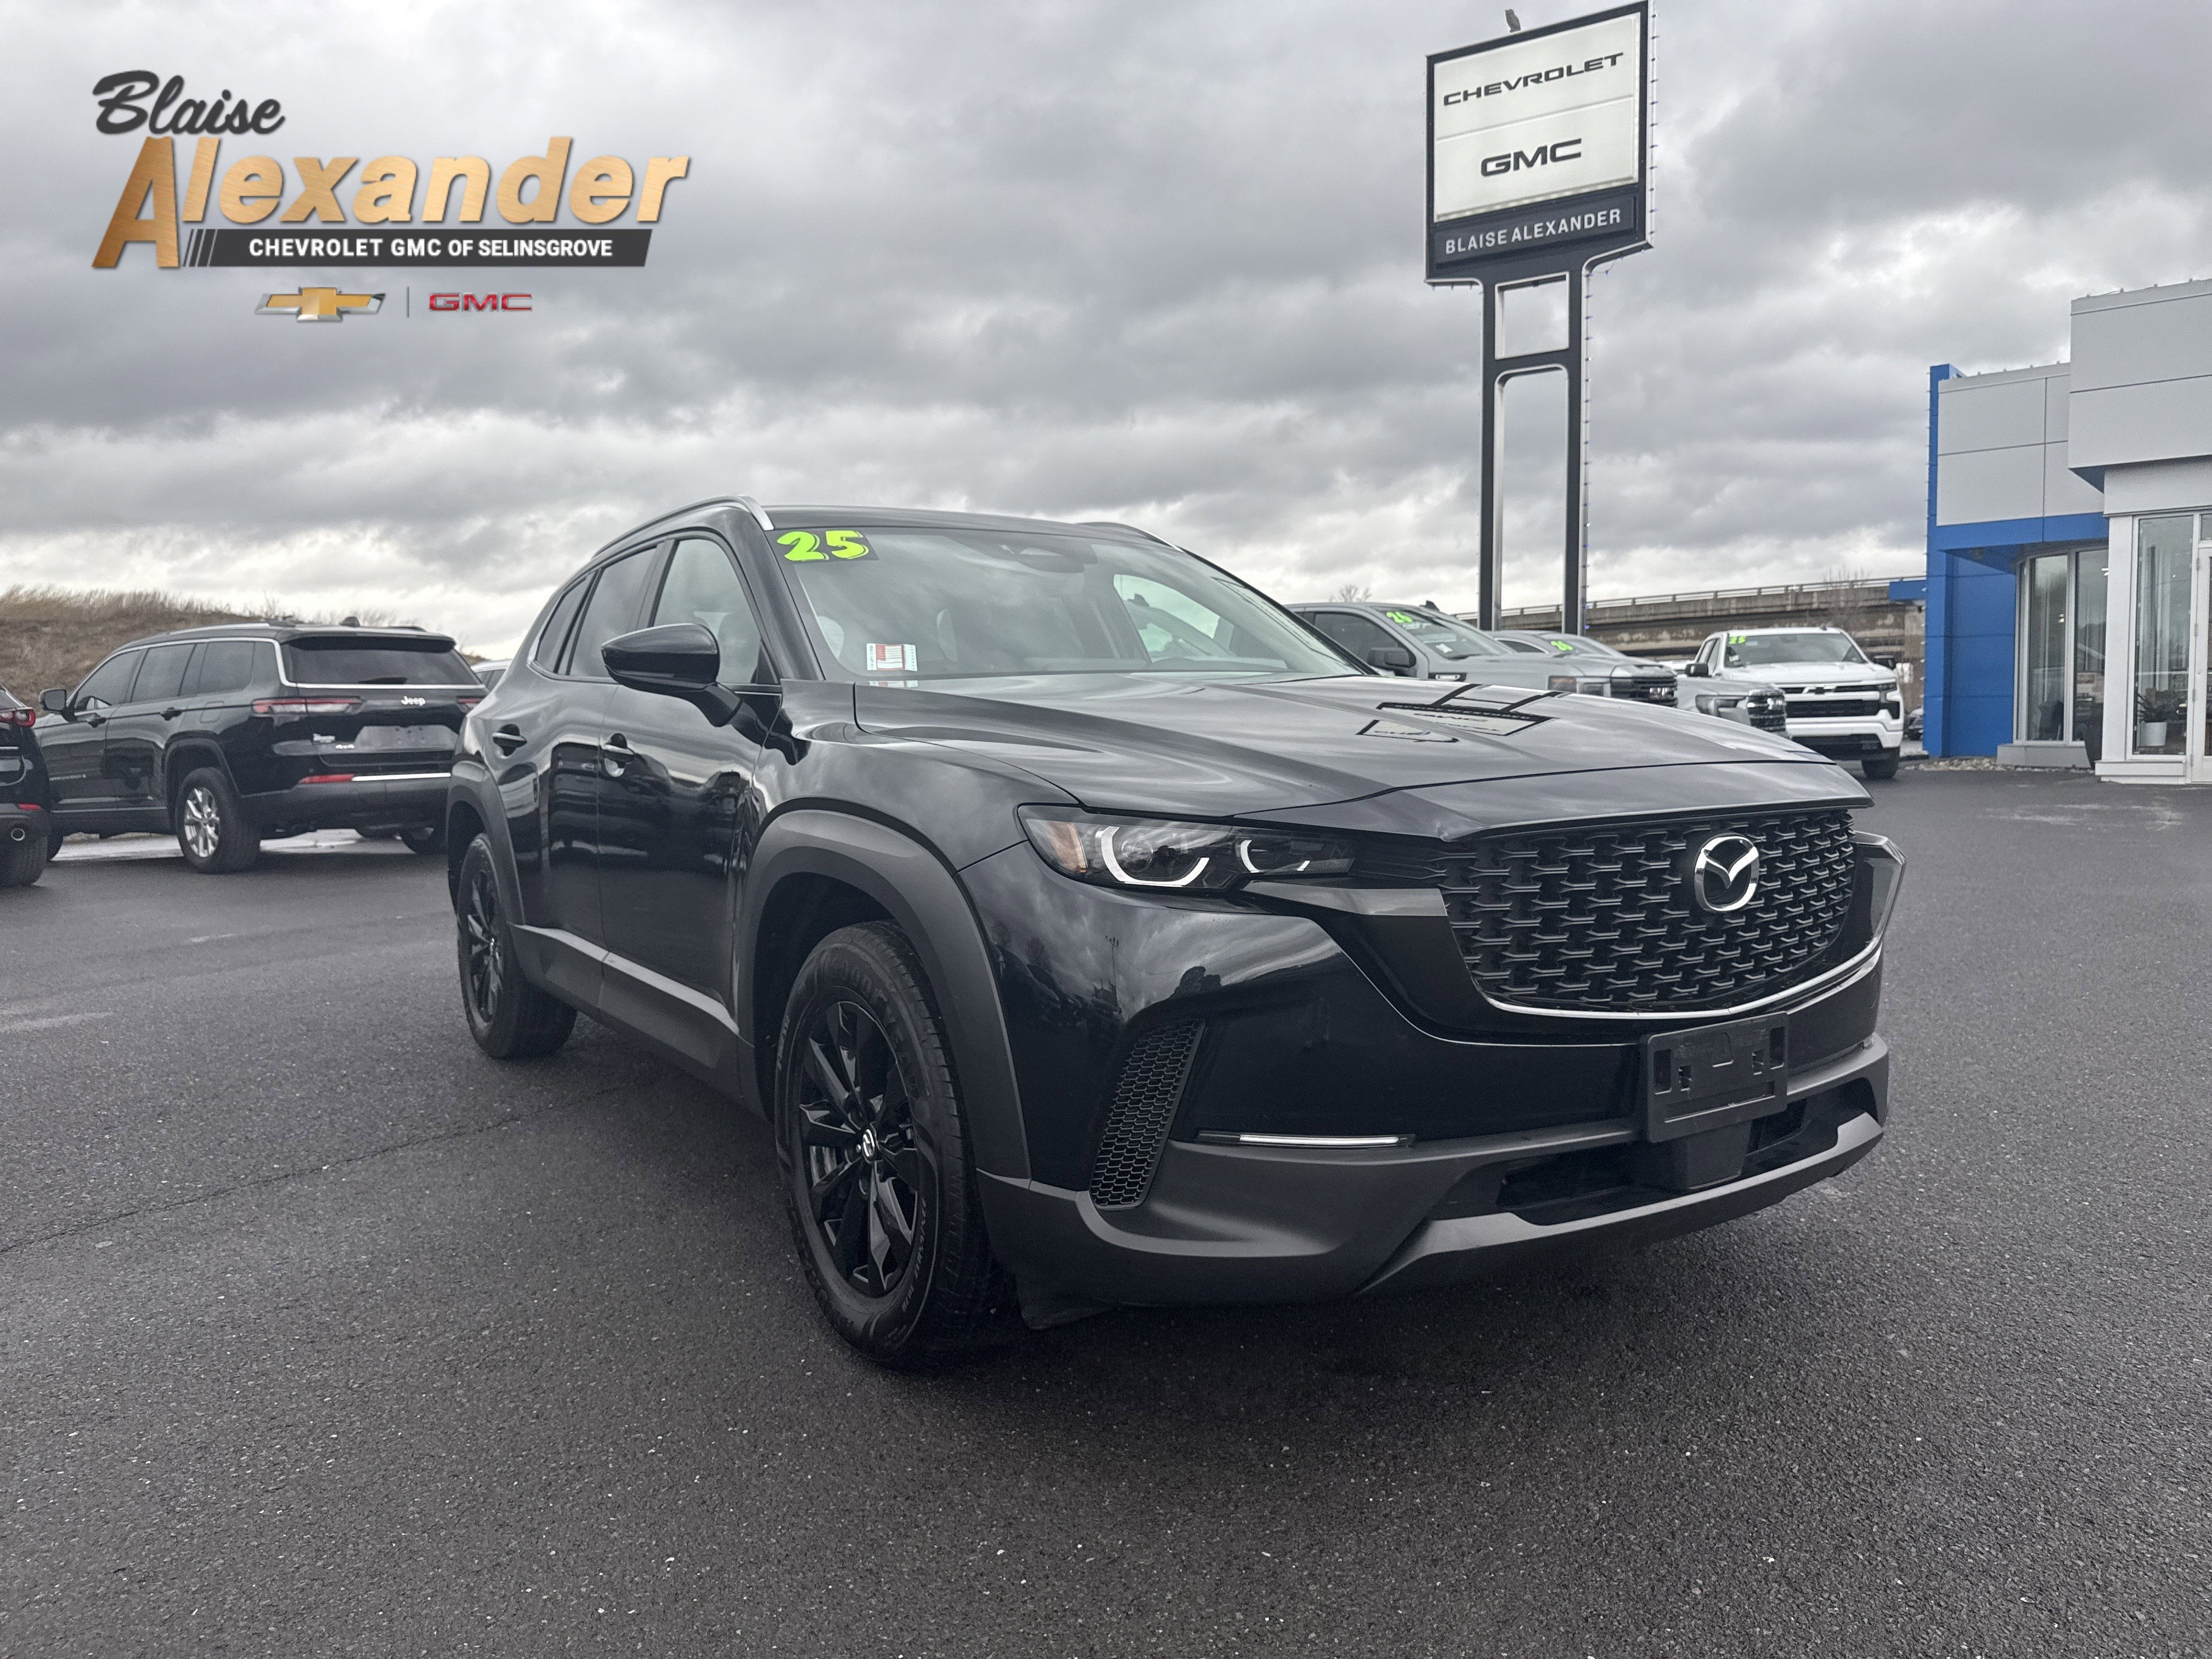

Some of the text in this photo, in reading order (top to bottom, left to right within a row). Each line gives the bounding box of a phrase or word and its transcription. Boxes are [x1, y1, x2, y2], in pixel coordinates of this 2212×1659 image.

[1443, 52, 1624, 106] CHEVROLET
[1481, 138, 1582, 177] GMC
[1445, 208, 1621, 255] BLAISE ALEXANDER
[777, 529, 869, 562] 25
[400, 696, 426, 706] Jeep
